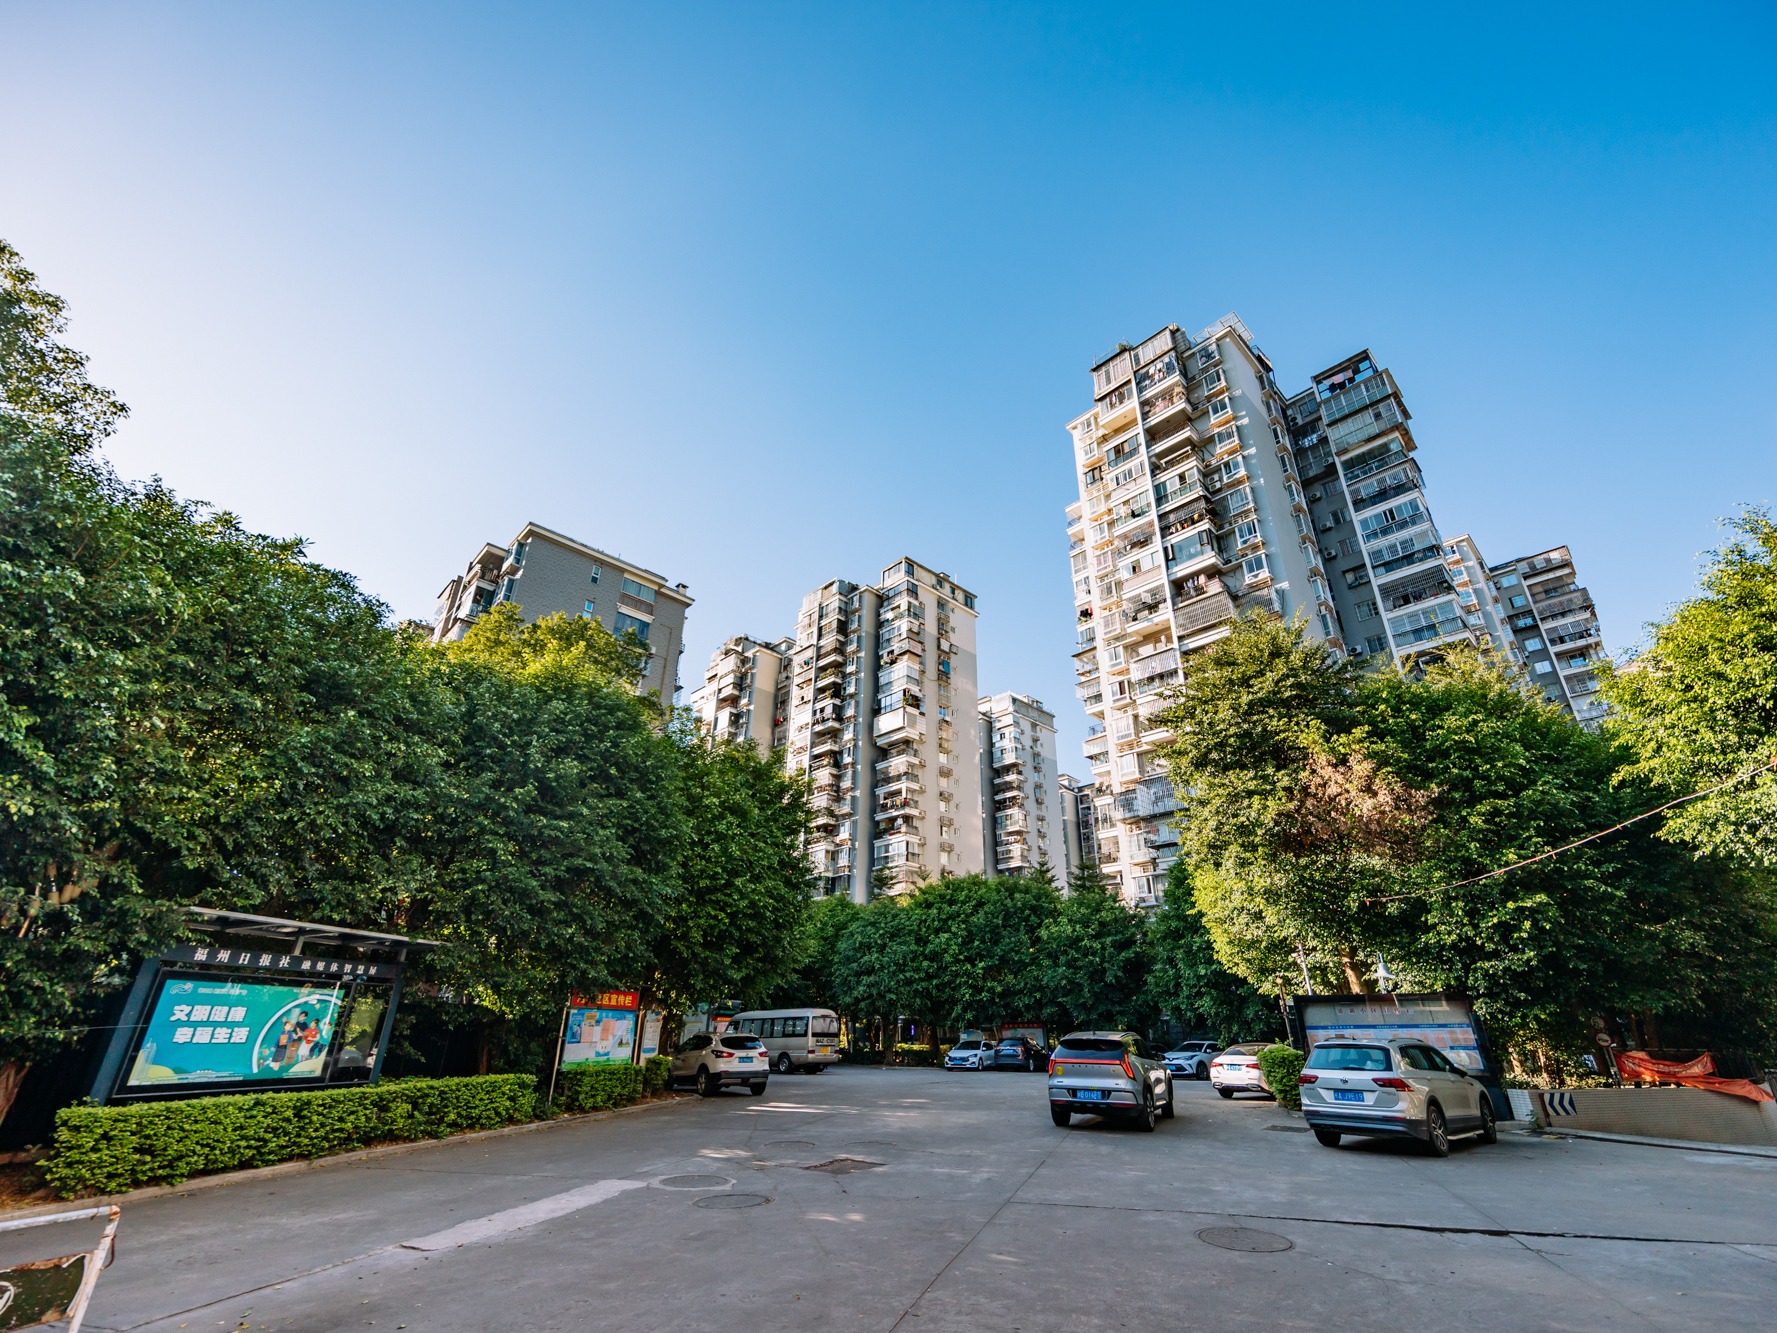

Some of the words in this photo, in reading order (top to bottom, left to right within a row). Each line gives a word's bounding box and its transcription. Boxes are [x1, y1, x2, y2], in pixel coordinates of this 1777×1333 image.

[193, 947, 293, 968] 福州日报社
[300, 960, 378, 976] 融媒体智慧屏
[576, 992, 633, 1006] 区宣传栏
[169, 1004, 248, 1022] 文明健康
[172, 1026, 250, 1044] 幸福生活
